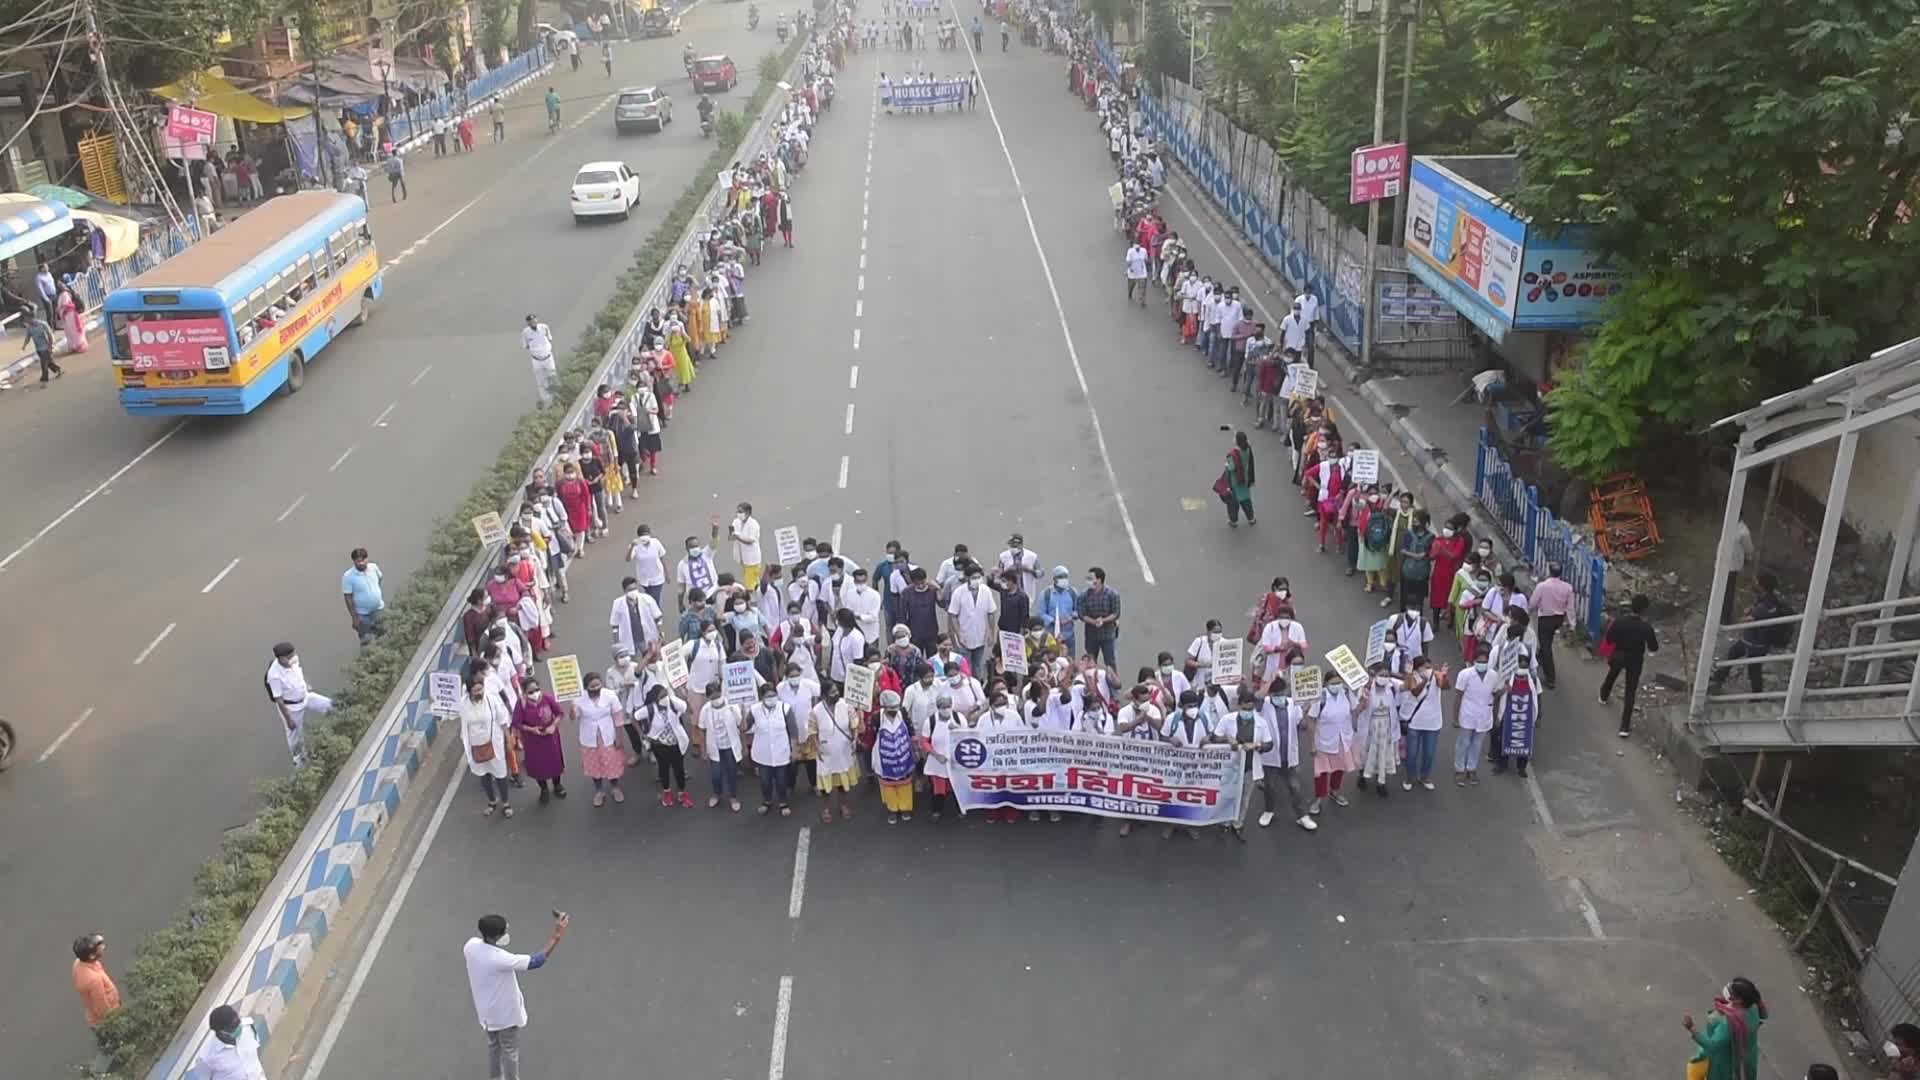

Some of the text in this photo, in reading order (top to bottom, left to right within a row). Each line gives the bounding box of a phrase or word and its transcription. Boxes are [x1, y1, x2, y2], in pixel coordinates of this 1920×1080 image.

[894, 83, 961, 98] NURSES UNITY
[173, 109, 213, 130] 100%
[1357, 154, 1400, 176] 100%
[130, 325, 186, 344] 100%
[728, 667, 747, 676] STOP
[727, 677, 752, 688] SALARY
[436, 695, 456, 703] EQUAL
[851, 693, 864, 702] PAY
[1297, 690, 1317, 698] ZERO
[1504, 746, 1530, 755] UNITY
[967, 766, 1221, 806] মহা মিছিল
